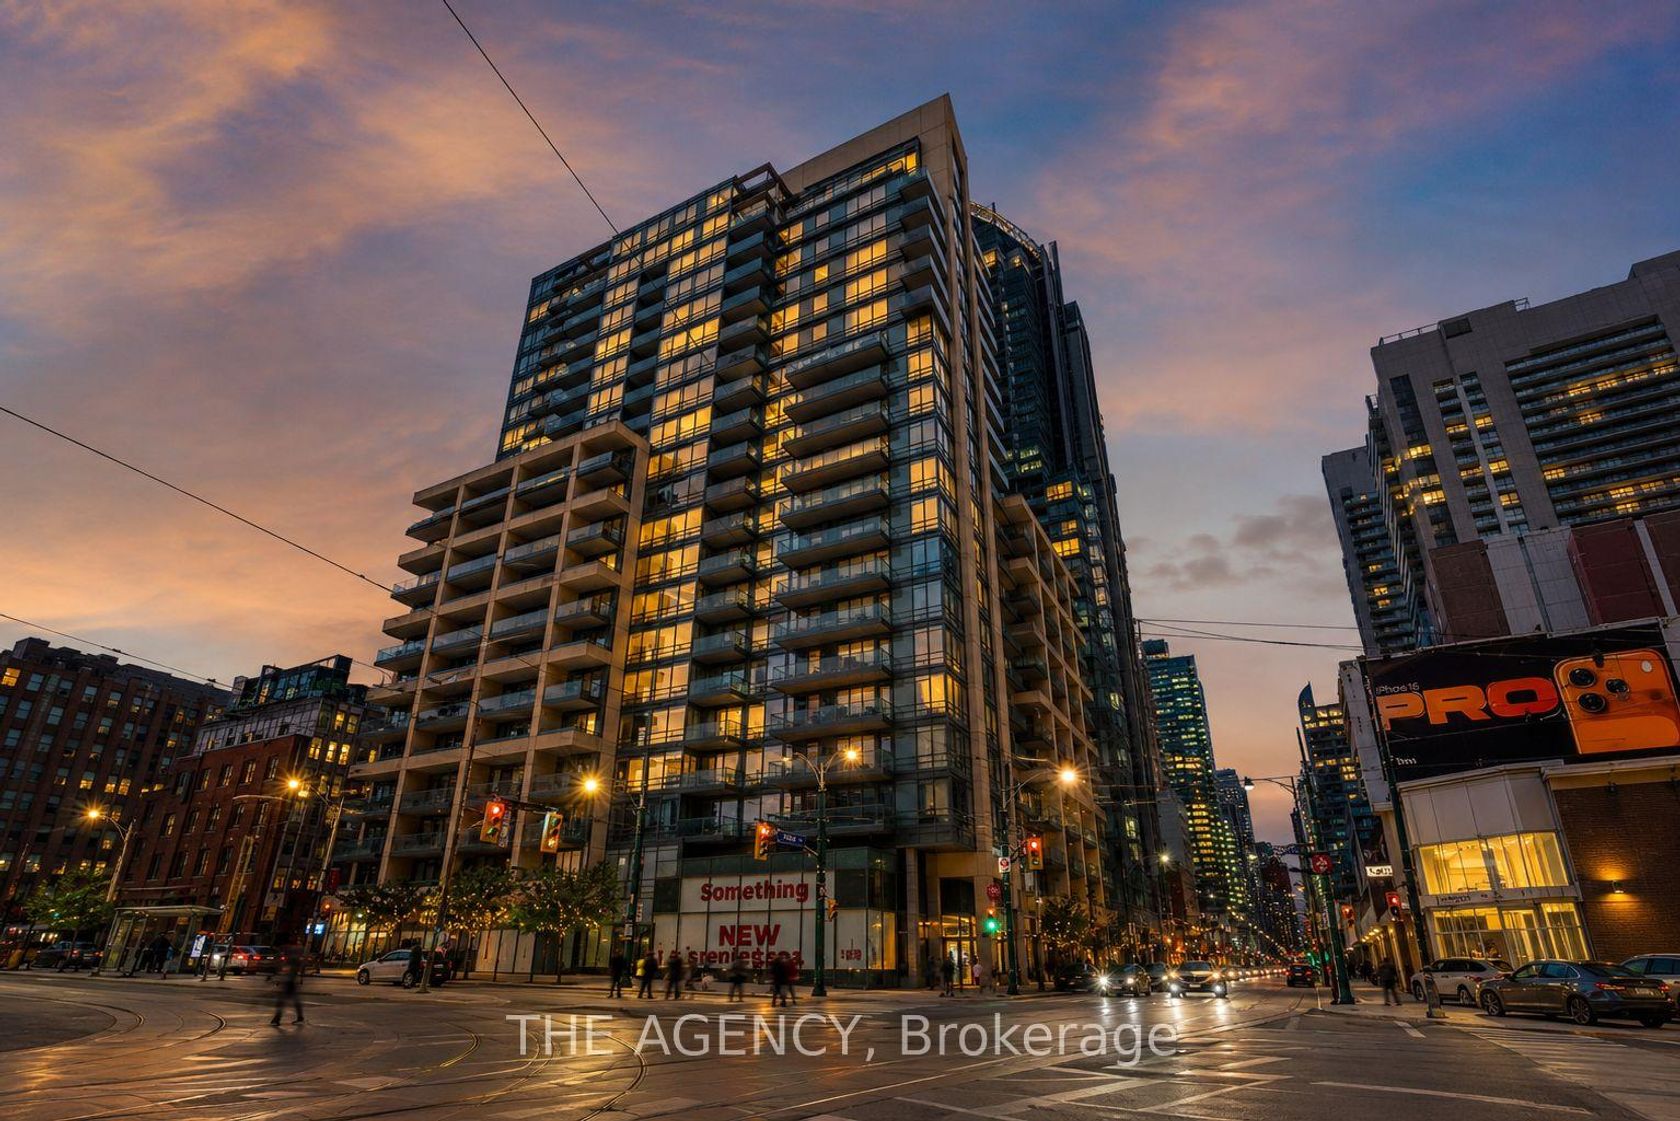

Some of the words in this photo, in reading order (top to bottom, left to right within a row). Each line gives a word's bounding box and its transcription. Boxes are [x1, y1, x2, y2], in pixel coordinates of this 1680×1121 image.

[1376, 677, 1559, 732] PRO
[700, 880, 809, 903] Something
[719, 924, 781, 946] NEW
